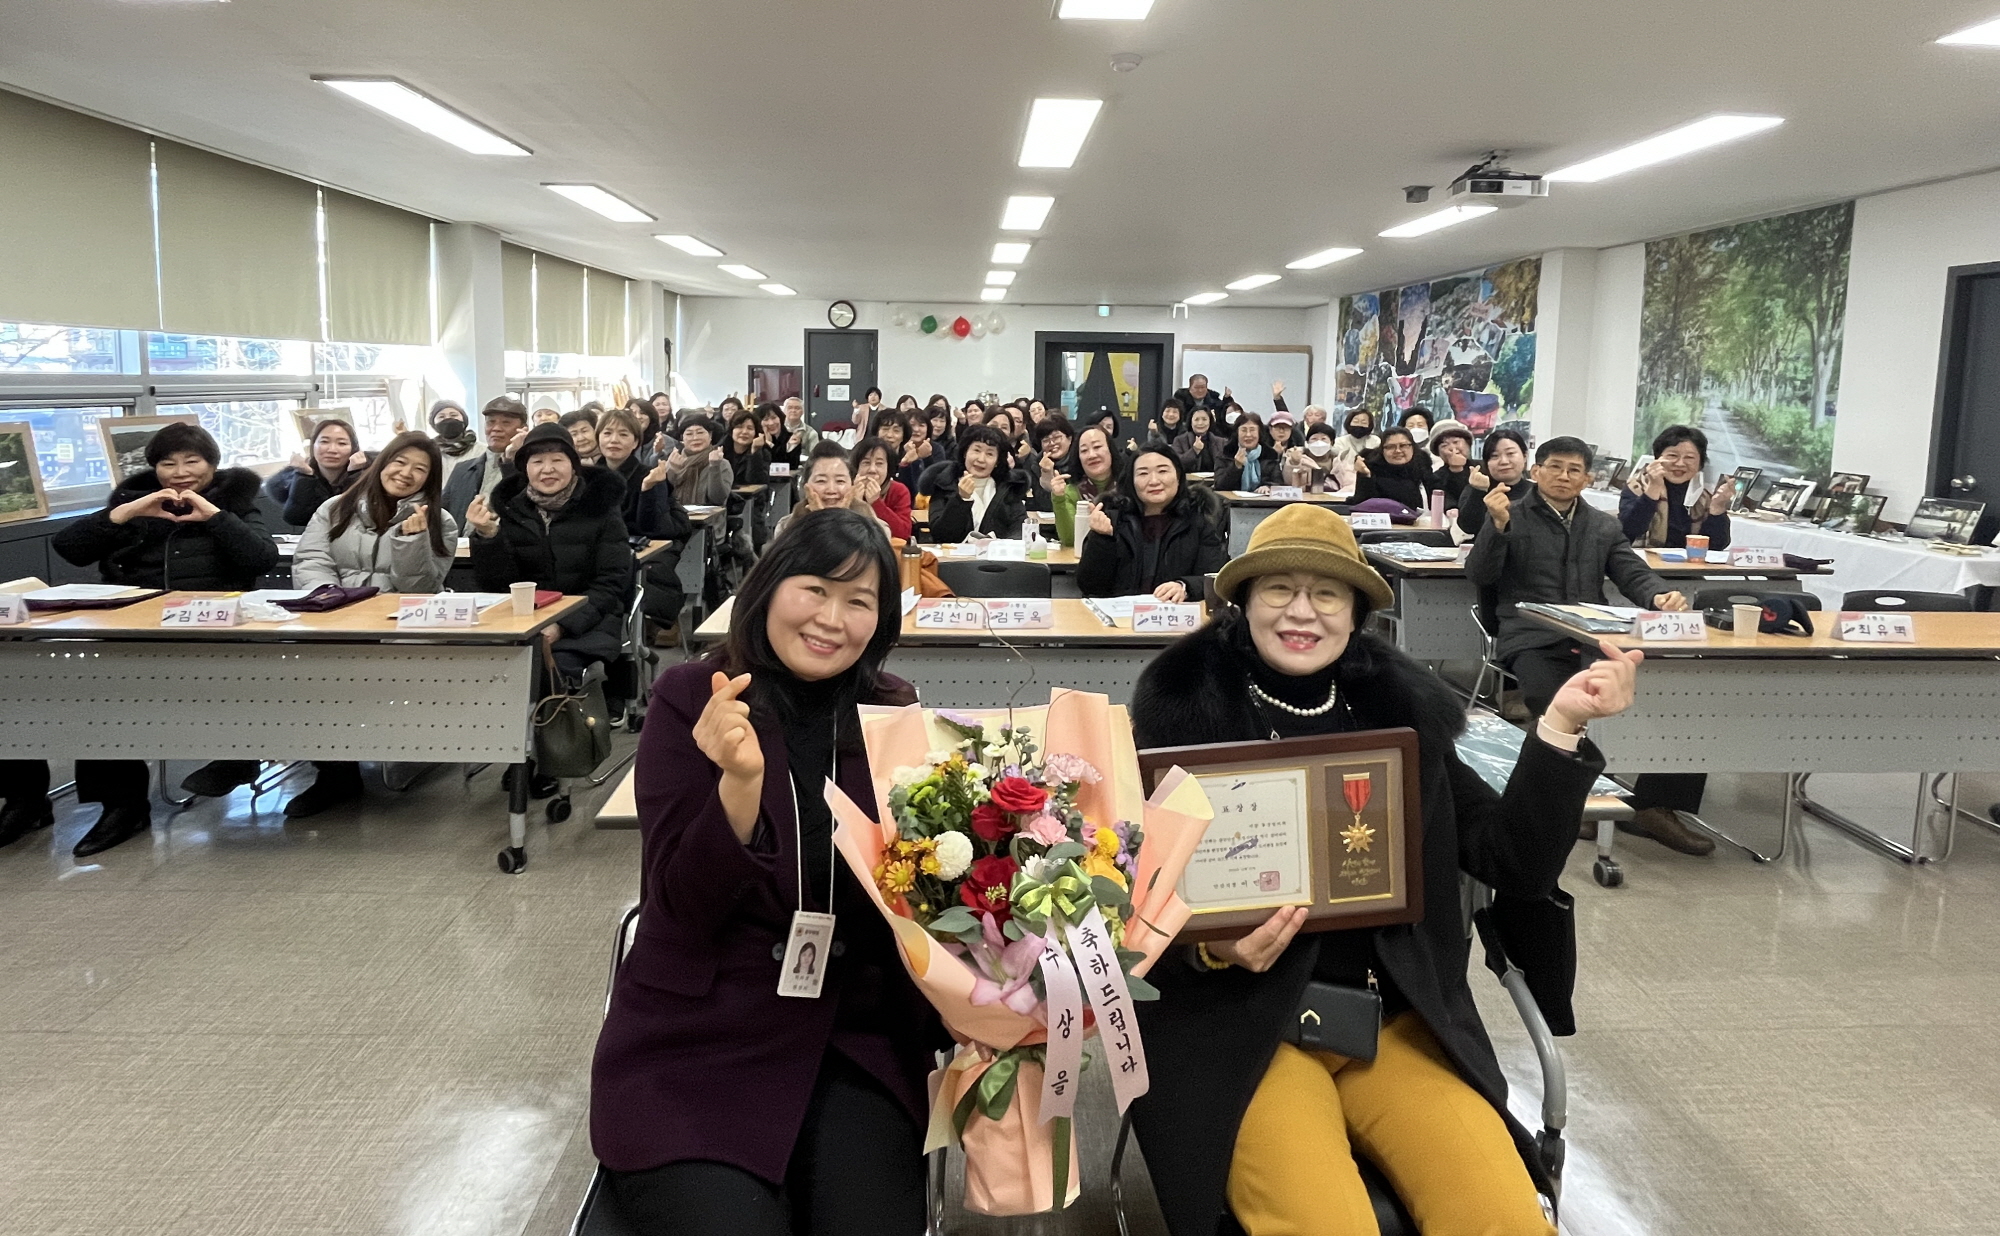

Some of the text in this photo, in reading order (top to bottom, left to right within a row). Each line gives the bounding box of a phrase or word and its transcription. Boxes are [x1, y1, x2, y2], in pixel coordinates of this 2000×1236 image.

[178, 610, 230, 622] 김선화
[933, 611, 977, 624] 김선미
[998, 611, 1041, 623] 김두옥
[1151, 614, 1195, 627] 박현경
[1658, 623, 1700, 635] 성기선
[1221, 802, 1258, 814] 표창장
[1080, 926, 1138, 1074] 축하드립니다
[1045, 946, 1075, 1096] 수상을
